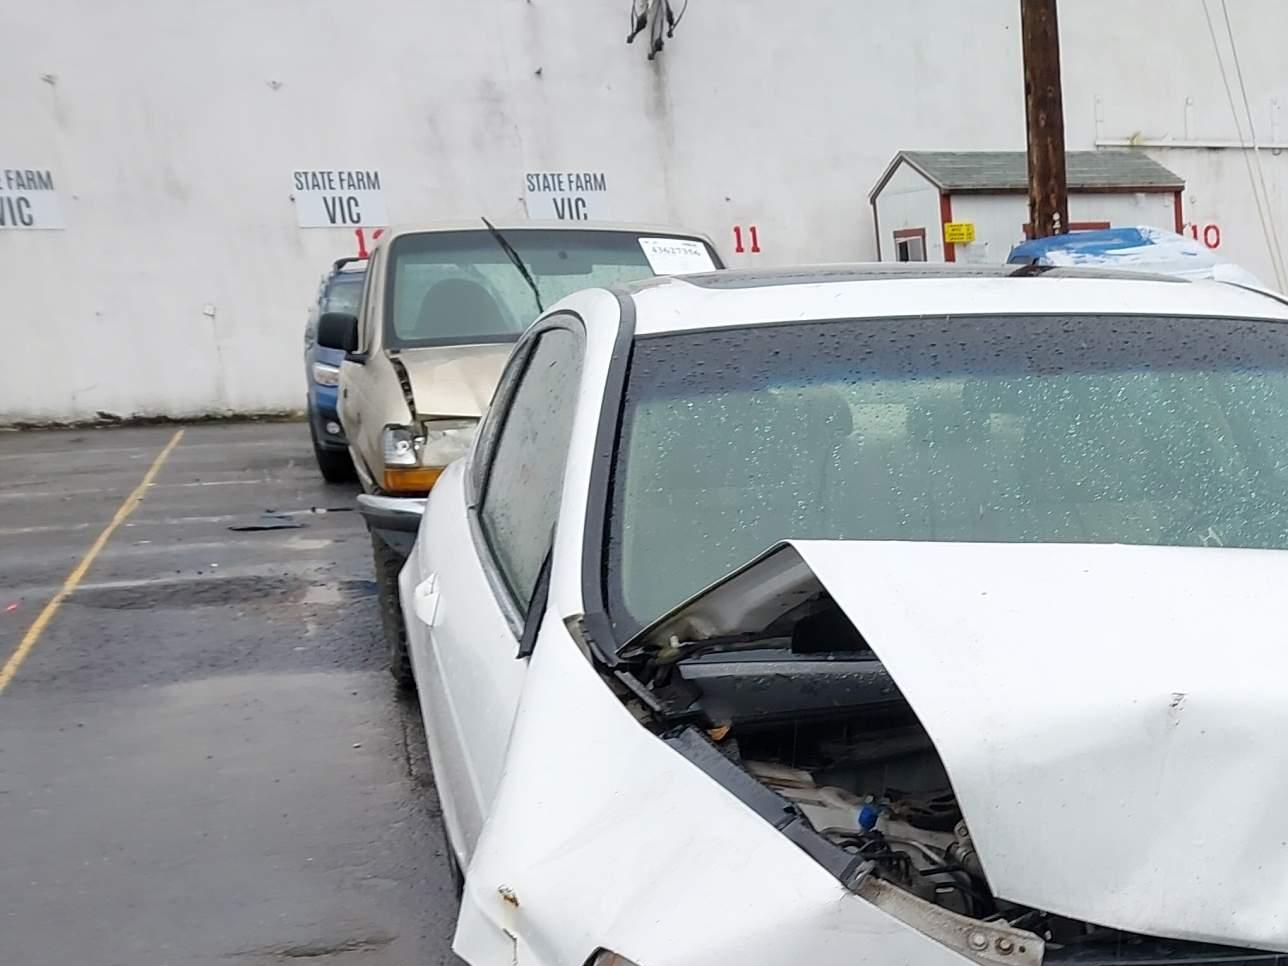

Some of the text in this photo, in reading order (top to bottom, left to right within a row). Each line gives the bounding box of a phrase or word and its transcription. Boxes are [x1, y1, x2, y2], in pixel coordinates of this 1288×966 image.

[4, 170, 54, 190] FARM
[294, 171, 381, 190] STATE FARM
[526, 173, 606, 192] STATE FARM
[322, 196, 361, 224] VIC
[552, 197, 588, 220] VIC
[355, 227, 384, 258] 1
[733, 226, 760, 253] 11
[1191, 224, 1220, 249] 10
